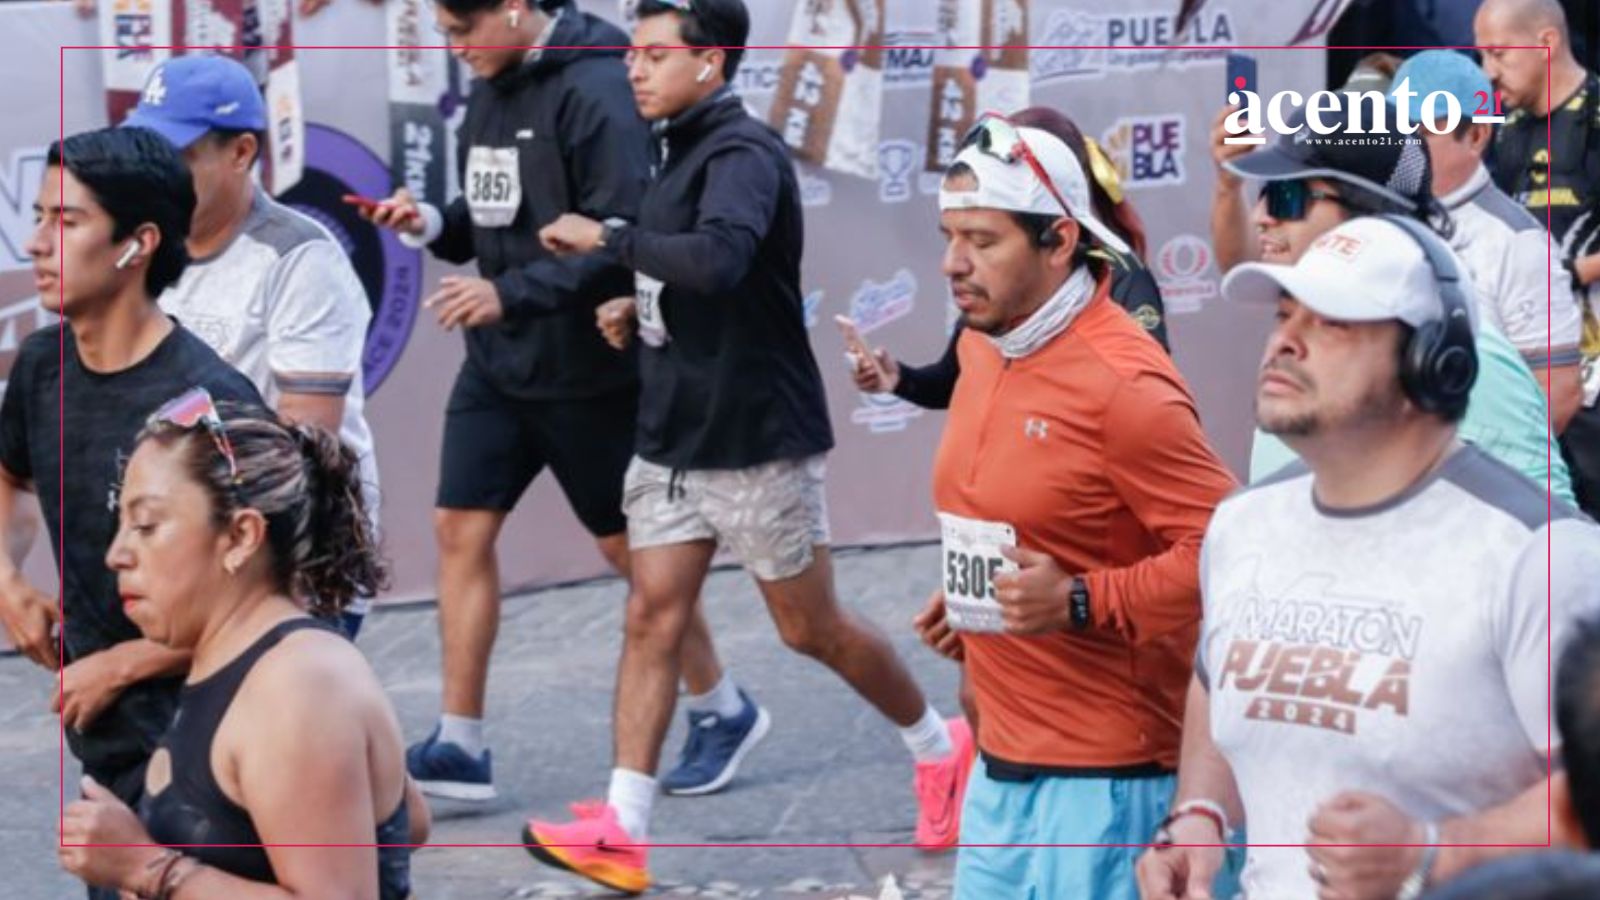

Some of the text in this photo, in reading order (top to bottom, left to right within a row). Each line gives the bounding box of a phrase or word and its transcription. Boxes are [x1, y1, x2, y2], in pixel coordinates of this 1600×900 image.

[1108, 13, 1232, 47] PUELA
[1132, 121, 1179, 150] PUE
[1132, 150, 1179, 181] BLA
[946, 550, 1003, 600] 5305
[1219, 639, 1411, 717] PUEBLA
[1256, 699, 1349, 730] 2024
